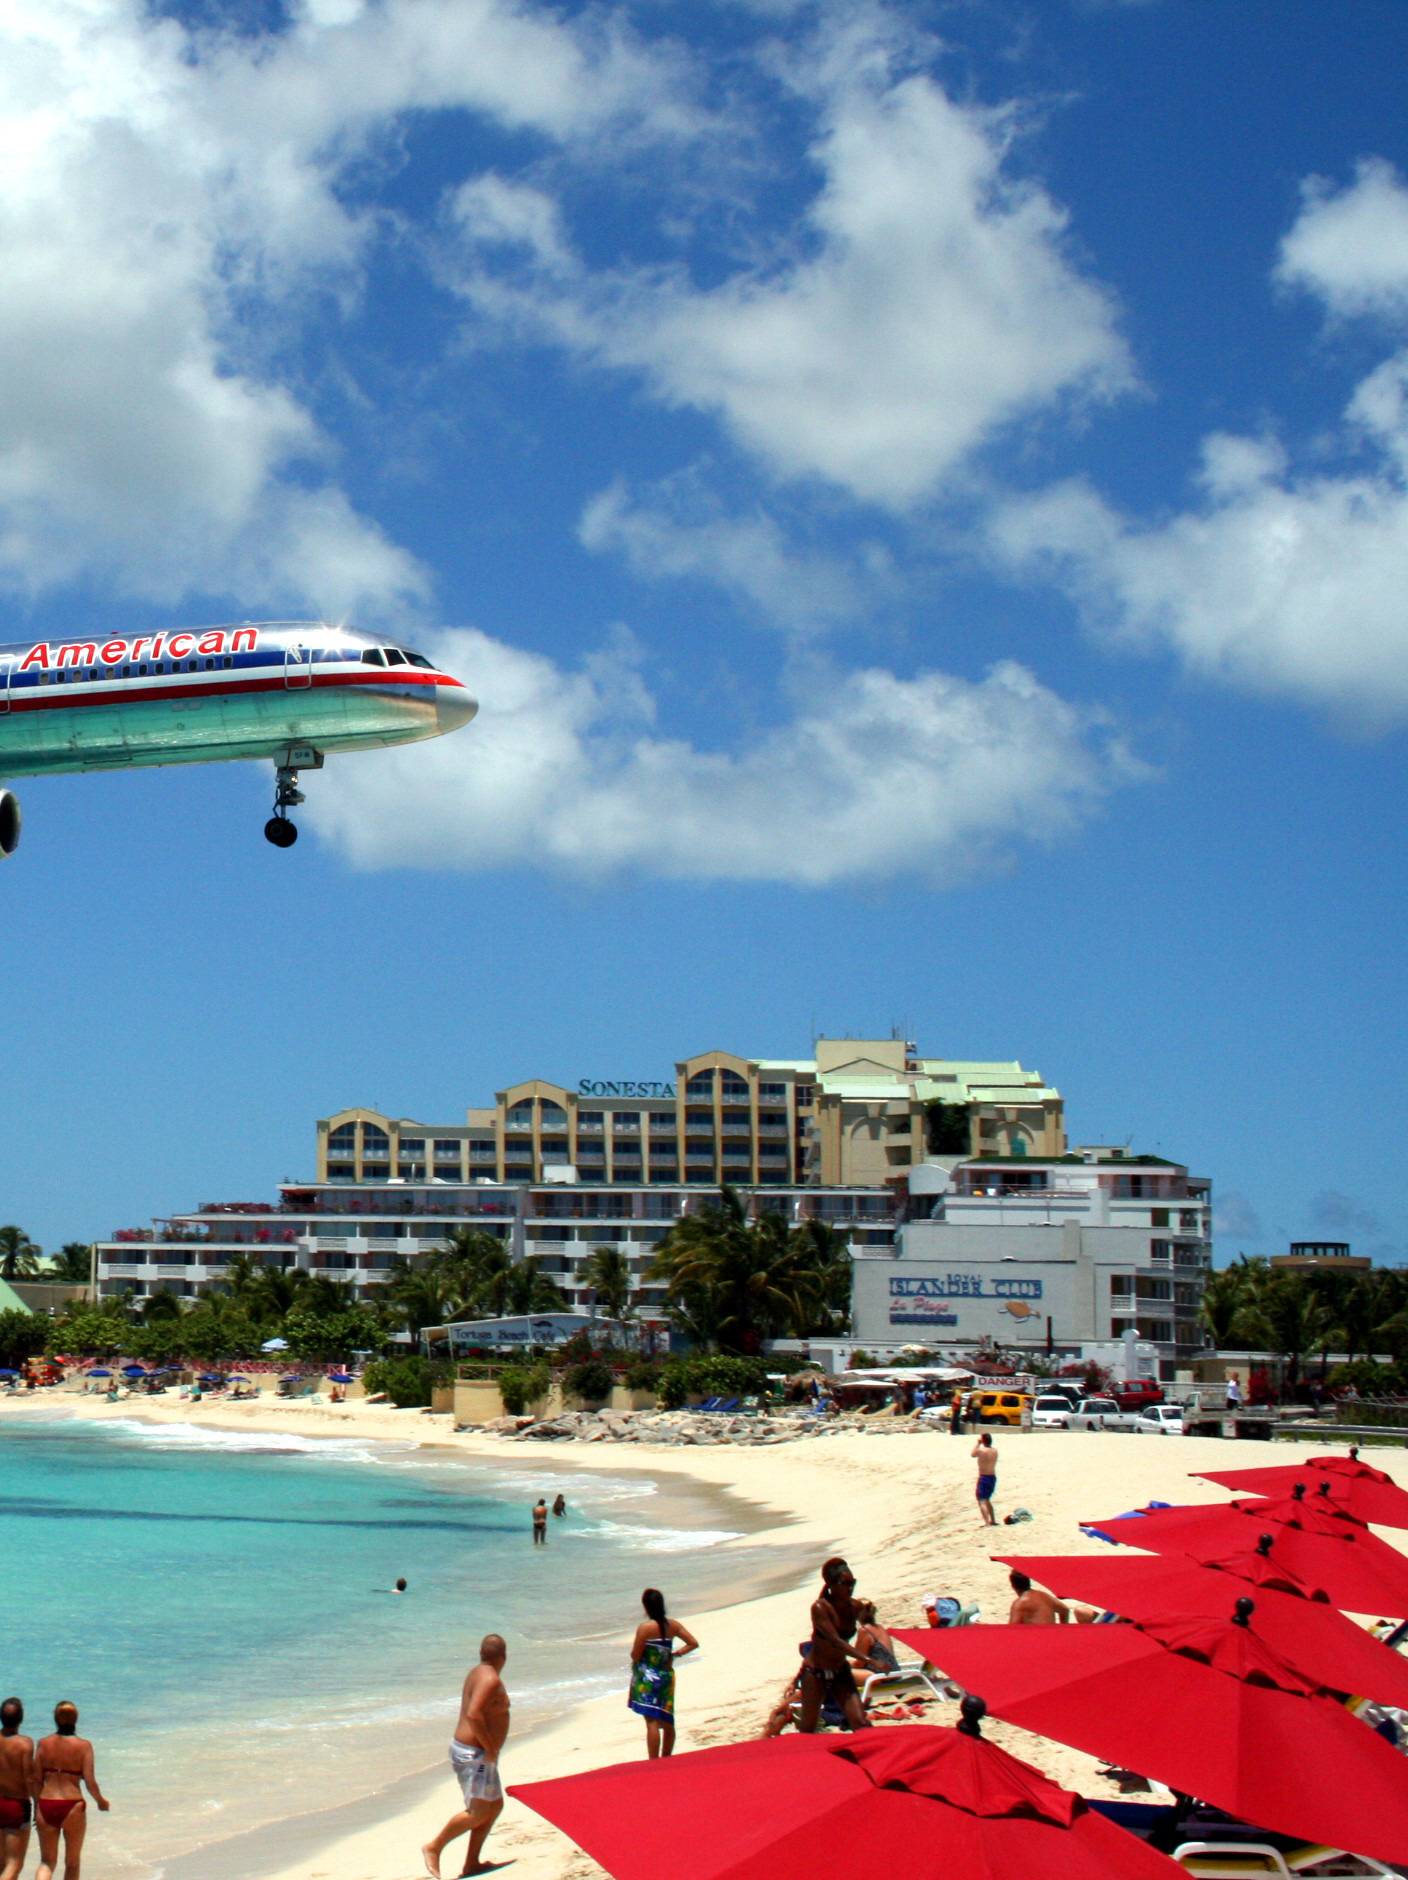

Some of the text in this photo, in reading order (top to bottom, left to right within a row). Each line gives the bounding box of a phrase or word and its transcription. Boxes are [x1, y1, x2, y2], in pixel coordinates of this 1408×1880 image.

[18, 628, 259, 672] American
[578, 1078, 676, 1098] SONESTA
[947, 1273, 983, 1282] ROYAL
[889, 1279, 1042, 1297] ISLANDER CLUB
[889, 1298, 907, 1311] La
[455, 1328, 491, 1340] Tortuga
[498, 1329, 529, 1340] Beach
[978, 1377, 1030, 1386] DANGER
